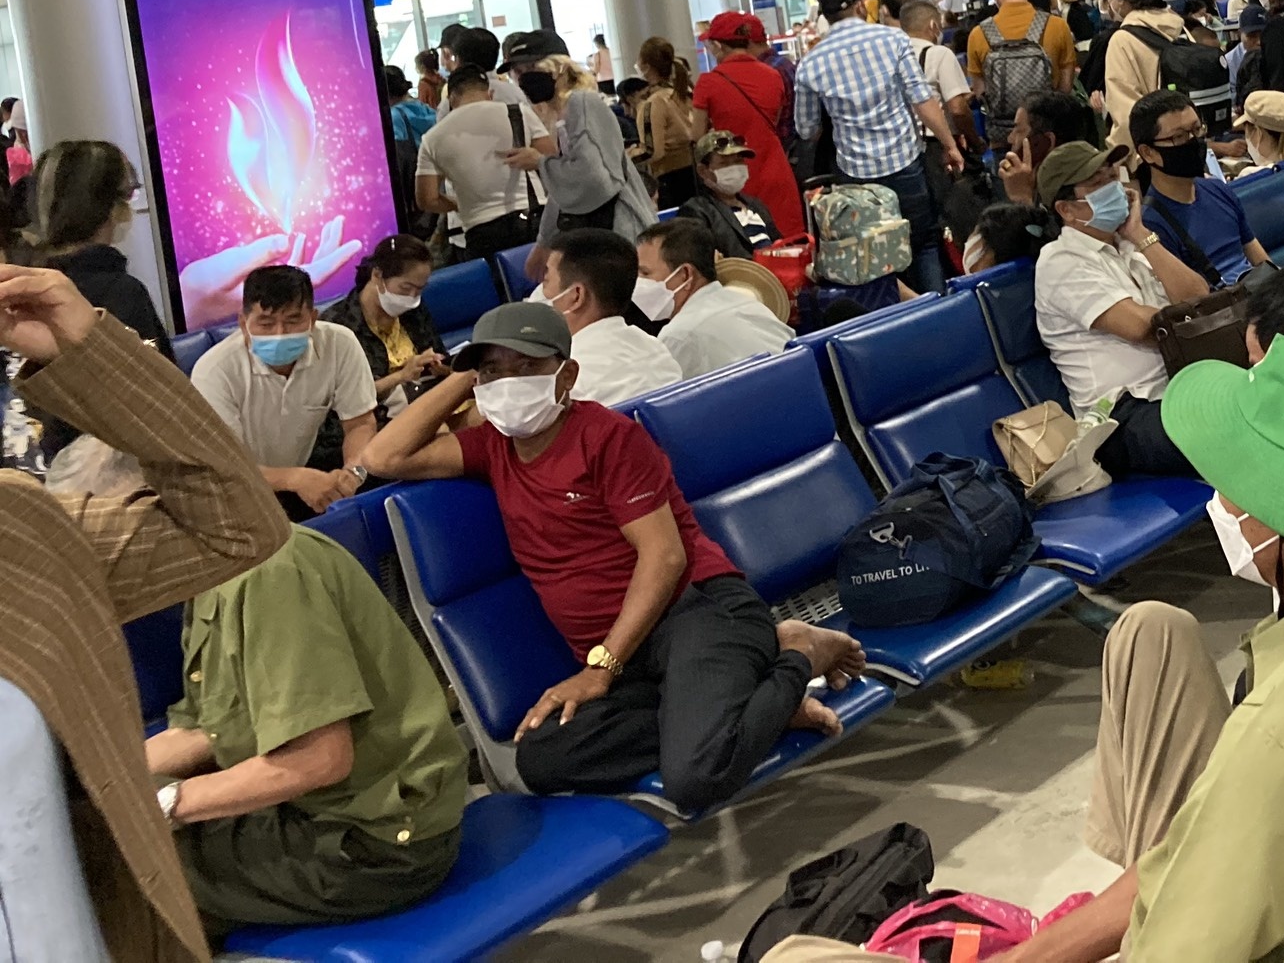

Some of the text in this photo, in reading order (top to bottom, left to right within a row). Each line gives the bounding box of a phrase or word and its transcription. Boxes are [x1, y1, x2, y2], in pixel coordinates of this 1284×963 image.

[851, 576, 862, 585] TO
[863, 569, 898, 583] TRAVEL
[898, 565, 913, 576] TO
